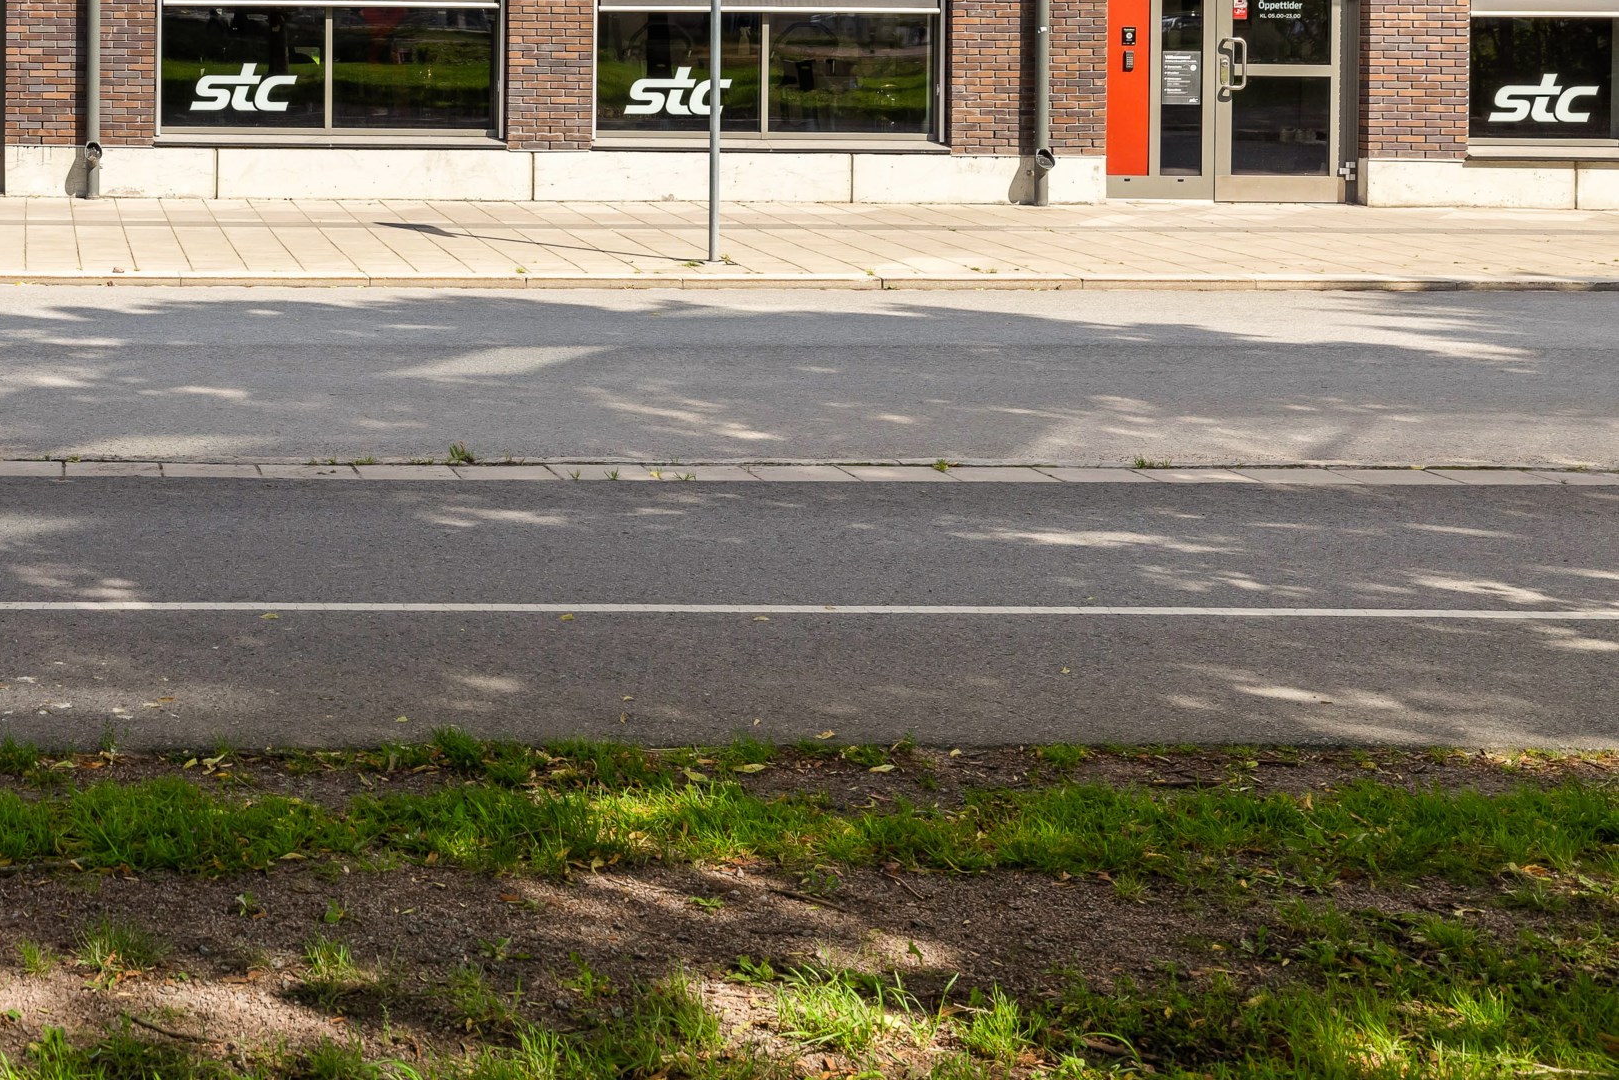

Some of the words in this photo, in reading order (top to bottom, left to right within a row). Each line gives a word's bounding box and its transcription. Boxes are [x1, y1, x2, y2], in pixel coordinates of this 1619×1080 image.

[1258, 0, 1303, 10] Öppettider
[189, 63, 297, 111] stc
[623, 67, 732, 115] stc
[1487, 73, 1600, 122] stc
